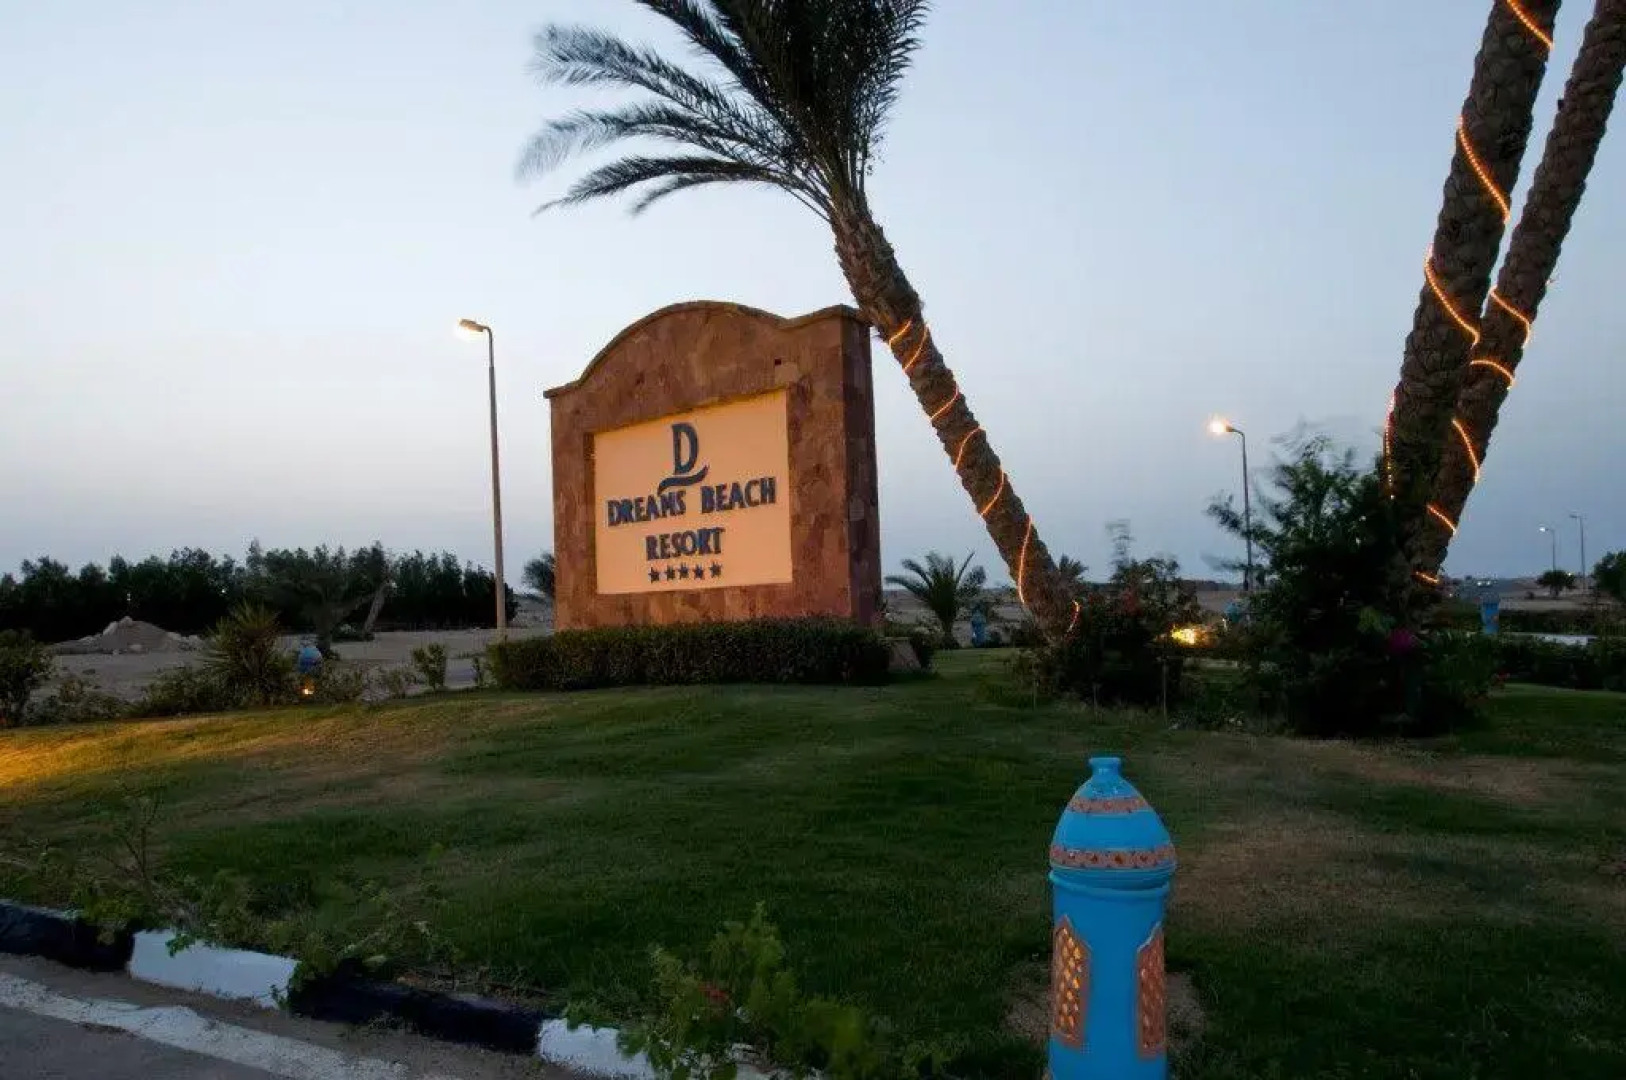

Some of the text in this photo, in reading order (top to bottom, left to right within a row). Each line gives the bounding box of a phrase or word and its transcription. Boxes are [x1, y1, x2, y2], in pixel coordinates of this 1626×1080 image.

[671, 422, 700, 476] D
[607, 476, 777, 527] DREAMS BEACH
[645, 526, 726, 561] RESORT
